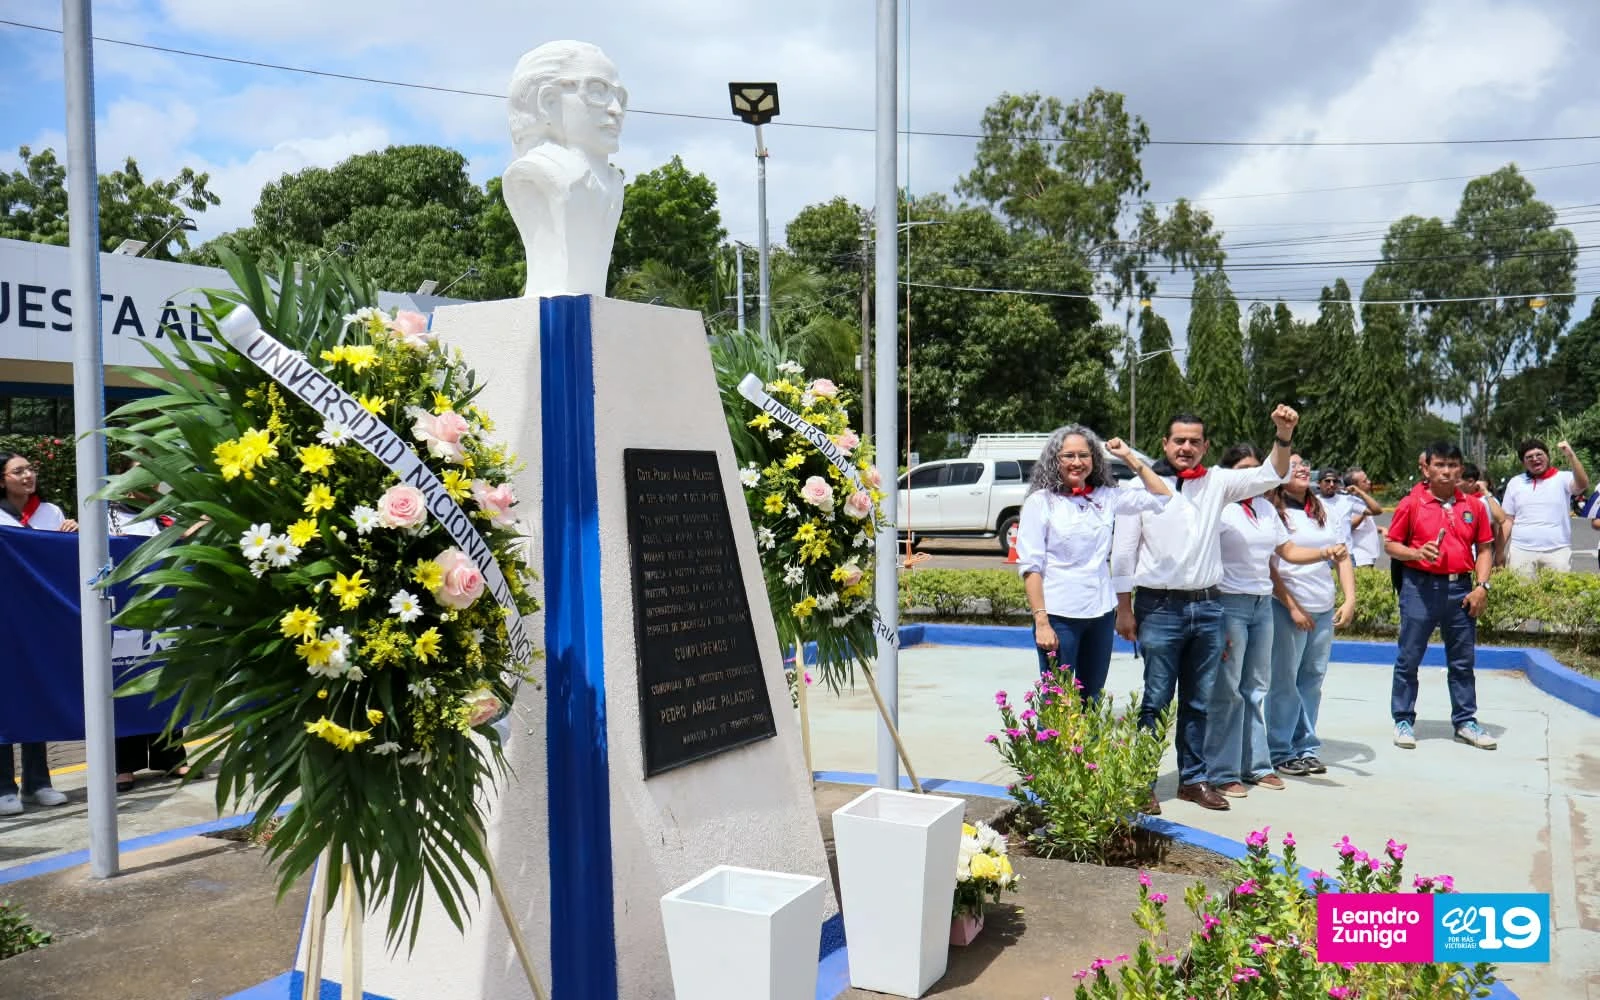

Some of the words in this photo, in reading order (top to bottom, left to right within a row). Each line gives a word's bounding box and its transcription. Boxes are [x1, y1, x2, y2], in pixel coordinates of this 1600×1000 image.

[156, 300, 213, 343] AL
[763, 398, 849, 473] UNIVERSIDAD
[247, 335, 405, 465] UNIVERSIDAD
[405, 463, 492, 582] NACIONAL
[674, 639, 728, 661] CUMPLIREMOS
[660, 704, 687, 724] PEDRO
[692, 696, 716, 715] ARAUZ
